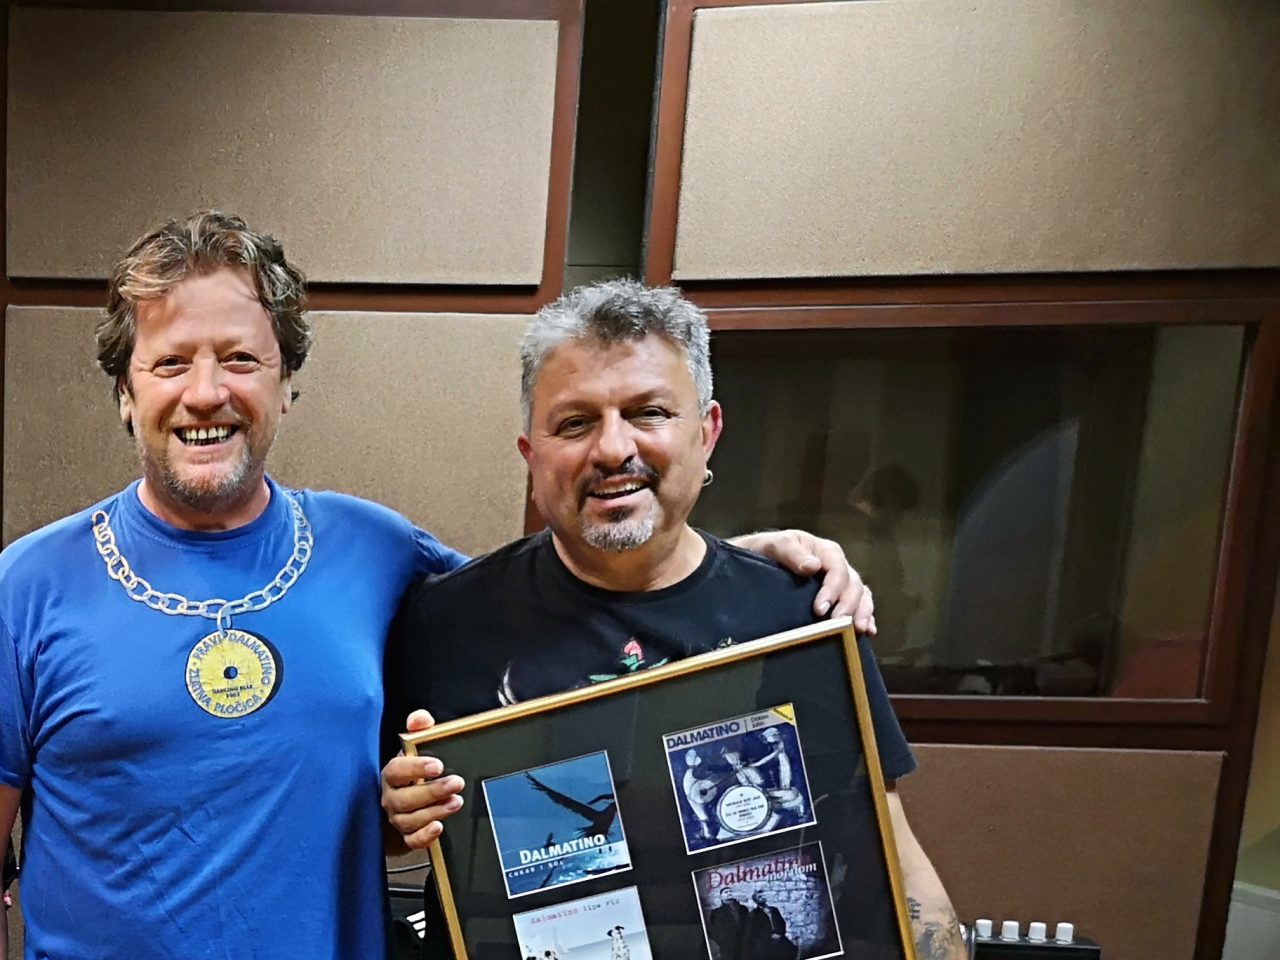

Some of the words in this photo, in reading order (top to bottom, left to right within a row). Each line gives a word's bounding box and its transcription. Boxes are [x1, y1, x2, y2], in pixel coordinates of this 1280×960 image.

[228, 632, 272, 685] DALMATINO
[666, 722, 740, 749] DALMATINO
[520, 834, 606, 864] DALMATINO
[707, 856, 810, 891] Dalmatin
